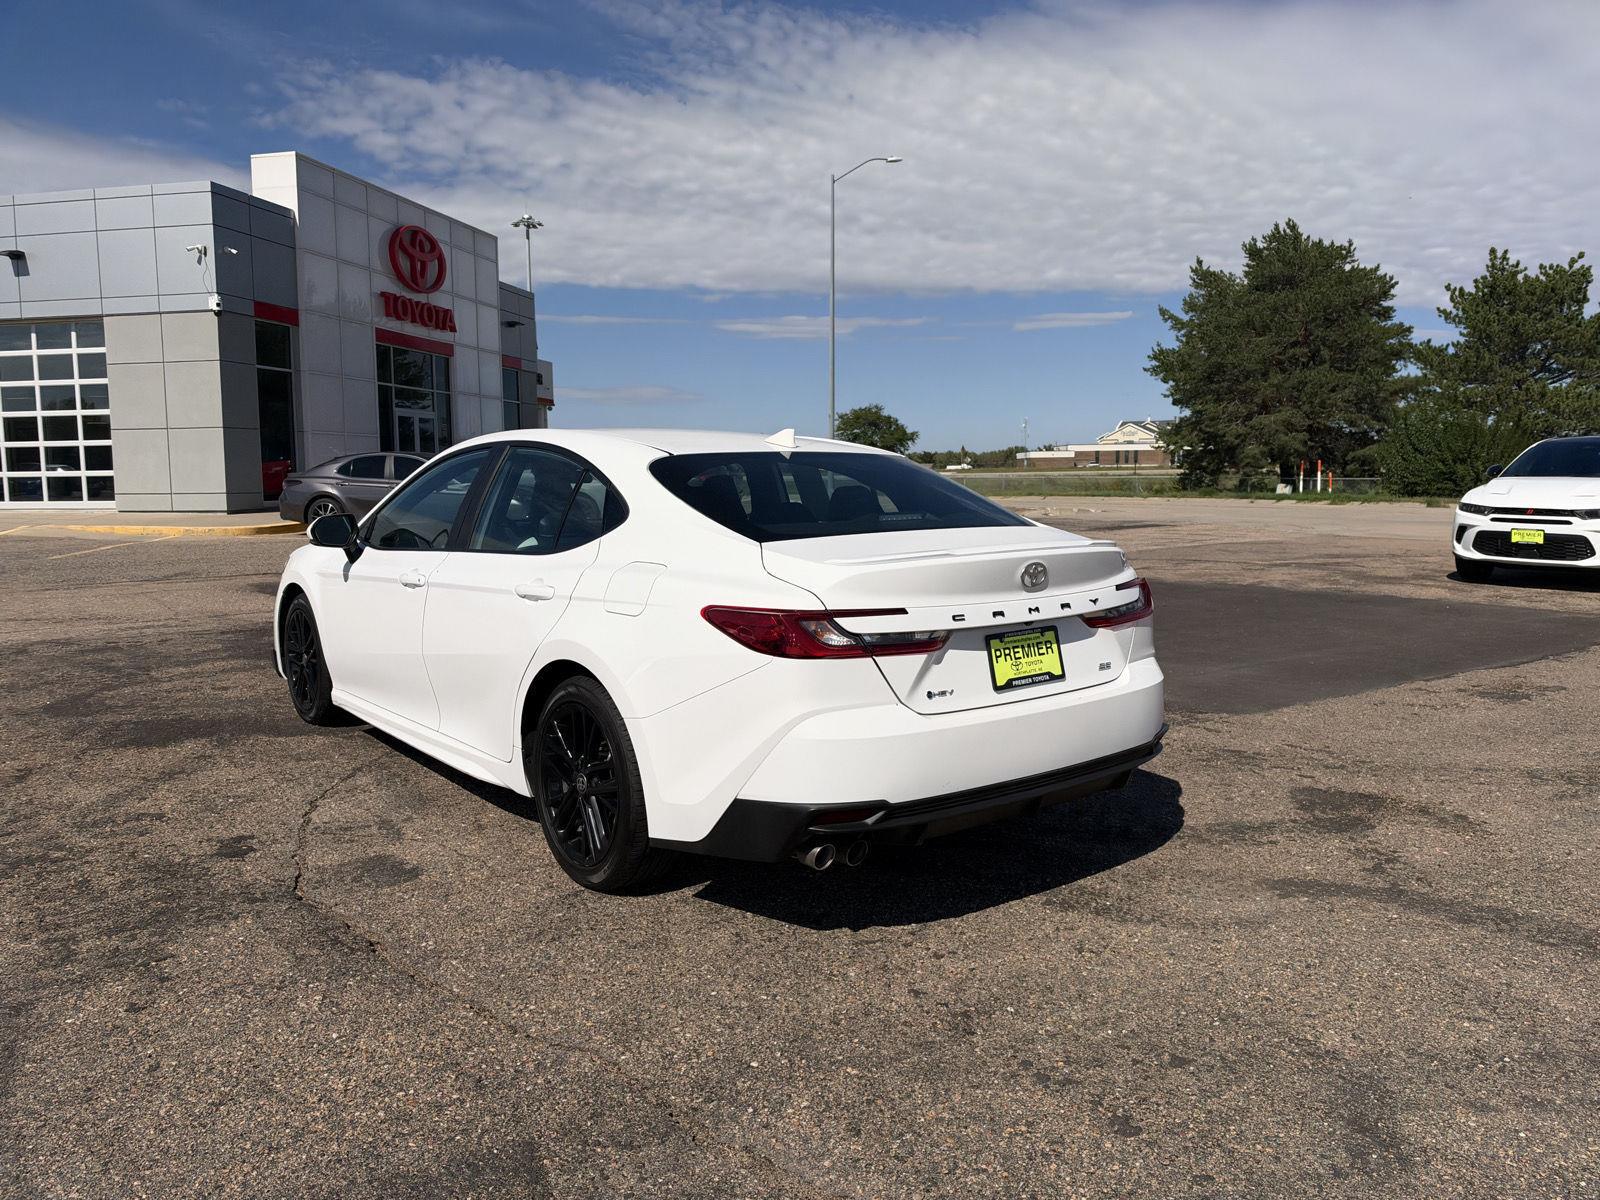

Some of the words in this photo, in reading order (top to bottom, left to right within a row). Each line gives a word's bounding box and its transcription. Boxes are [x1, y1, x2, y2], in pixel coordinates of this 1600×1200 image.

[379, 291, 457, 332] TOYOTA
[952, 598, 1099, 622] CAMRY
[994, 640, 1054, 663] PREMIER
[1025, 659, 1043, 667] TOYOTA
[1012, 677, 1032, 687] PREMIER
[1032, 674, 1050, 683] TOYOTA
